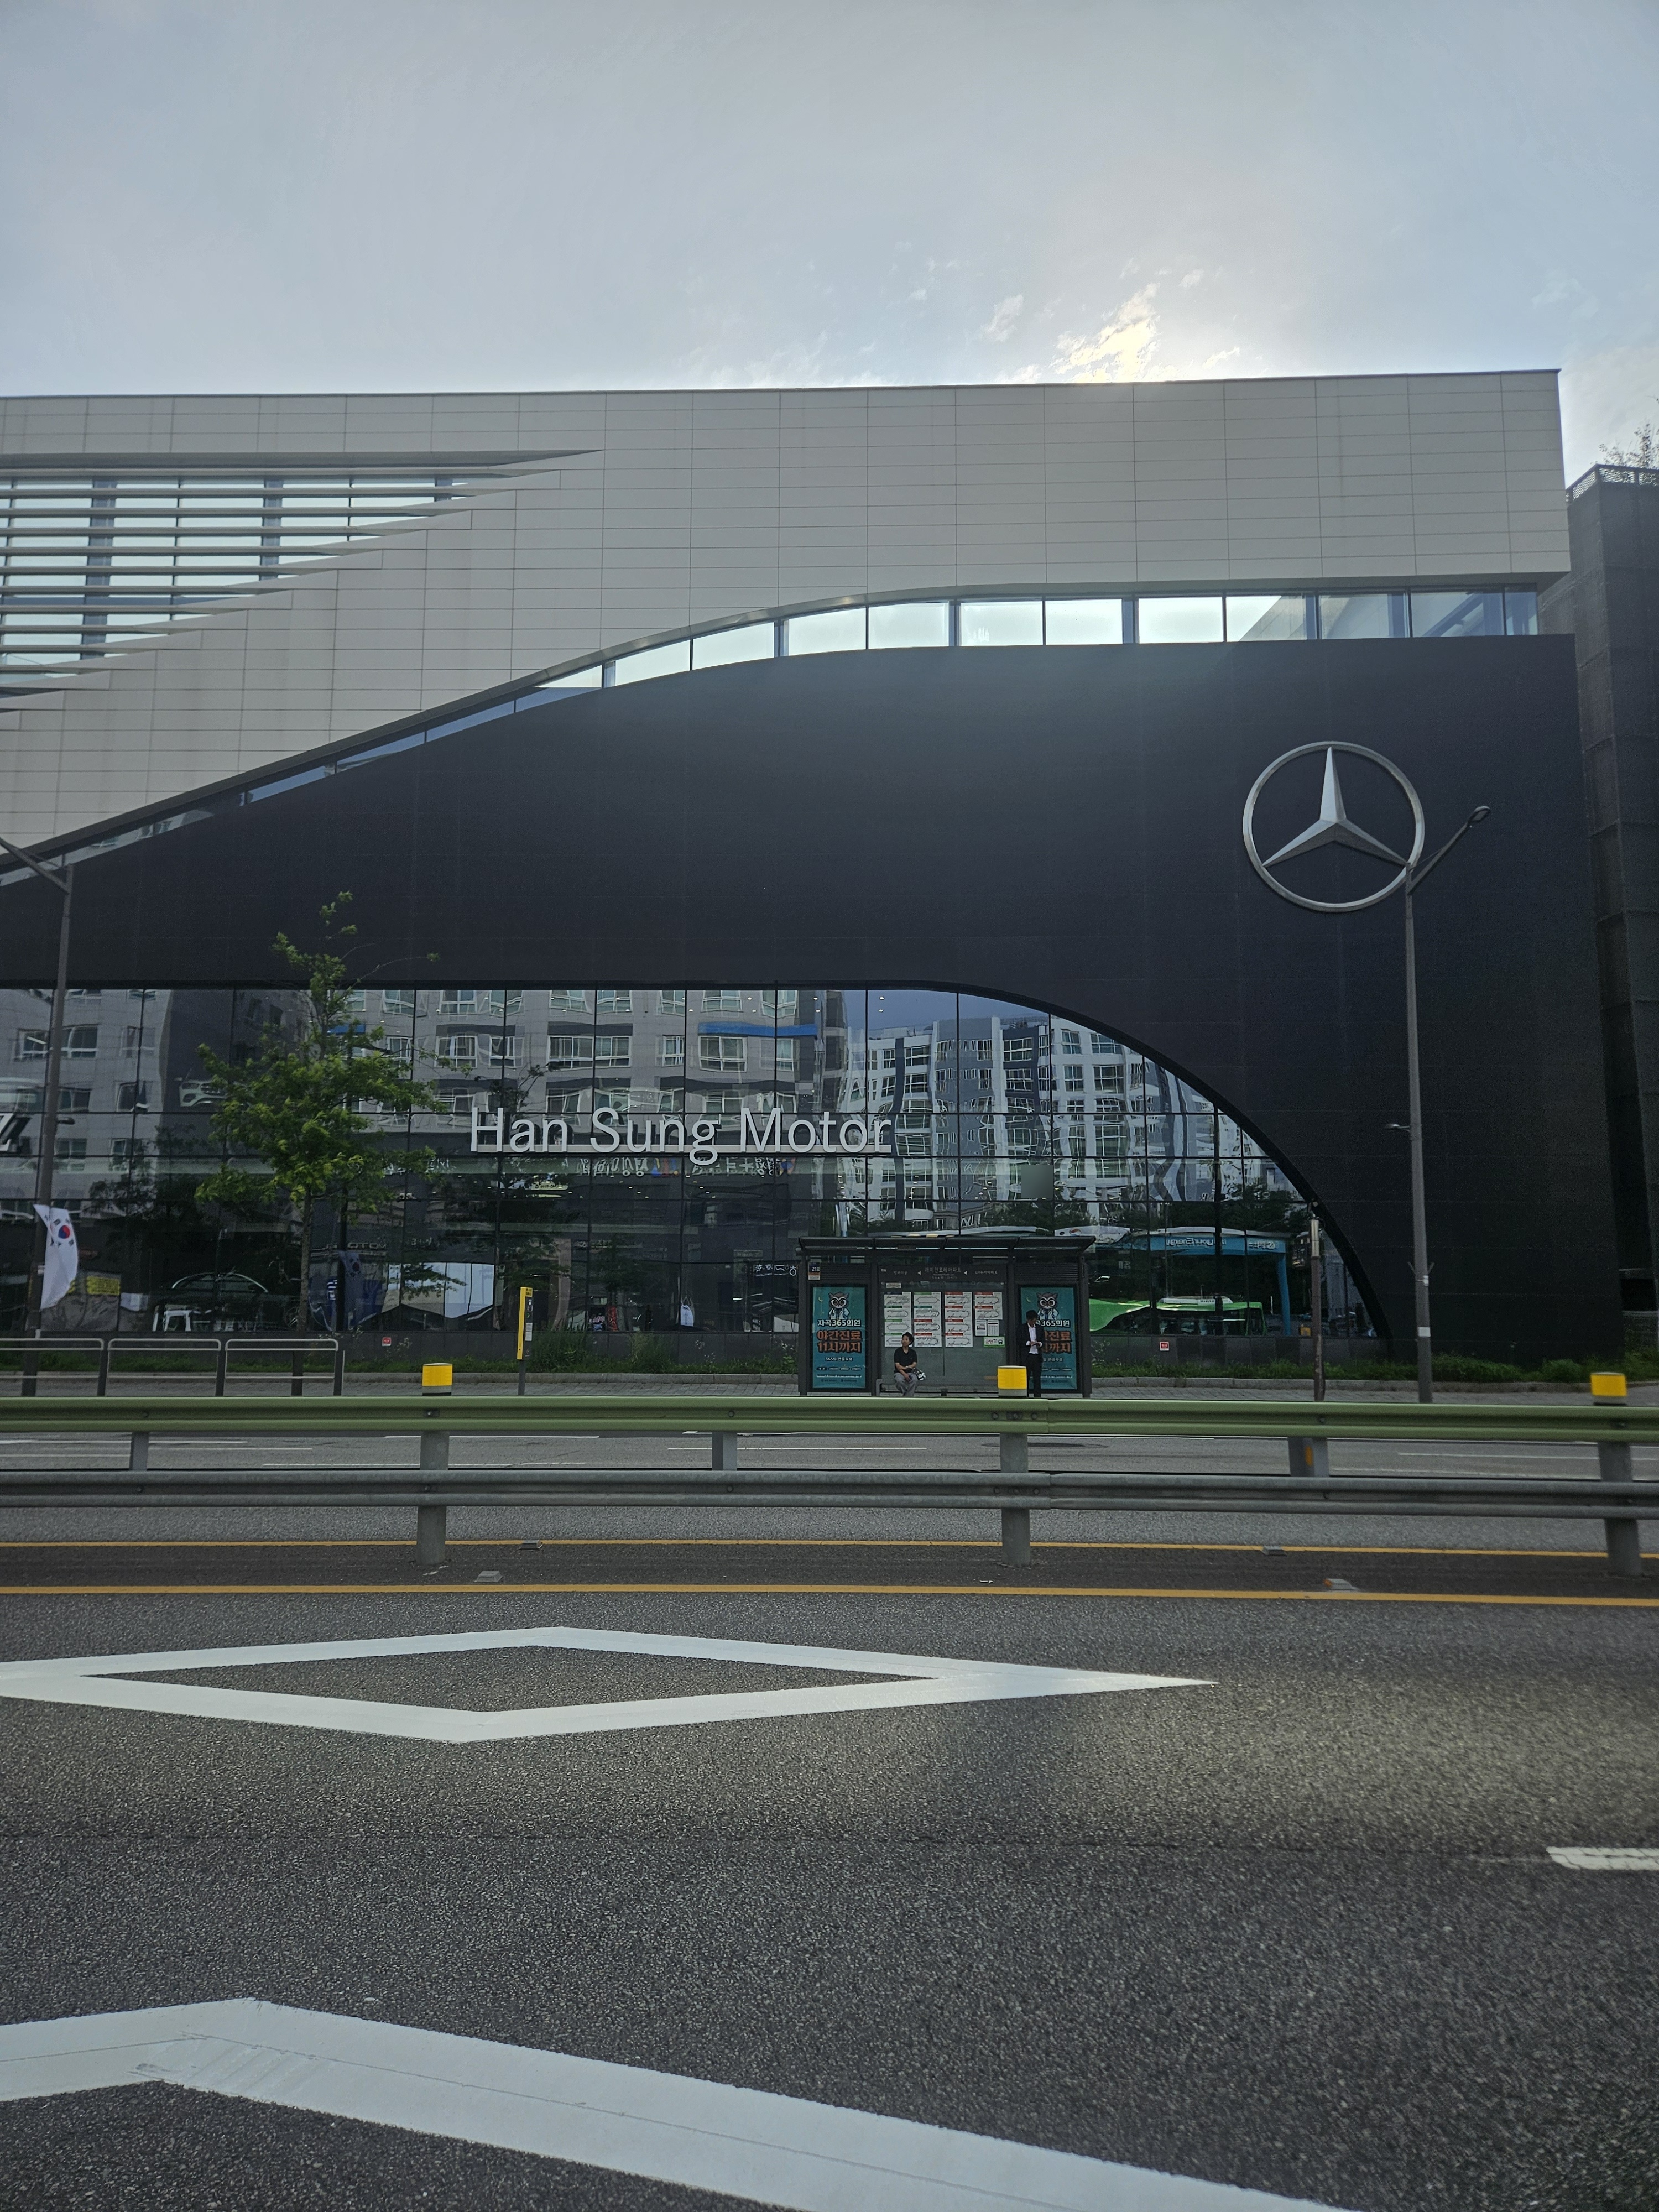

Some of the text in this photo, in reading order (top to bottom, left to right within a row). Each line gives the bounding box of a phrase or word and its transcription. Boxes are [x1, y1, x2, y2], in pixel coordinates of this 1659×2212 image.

[471, 1107, 891, 1165] Han Sung Motor
[817, 1319, 861, 1327] 자곡365의원
[817, 1330, 862, 1340] 야간진료
[817, 1342, 862, 1353] 11시까지
